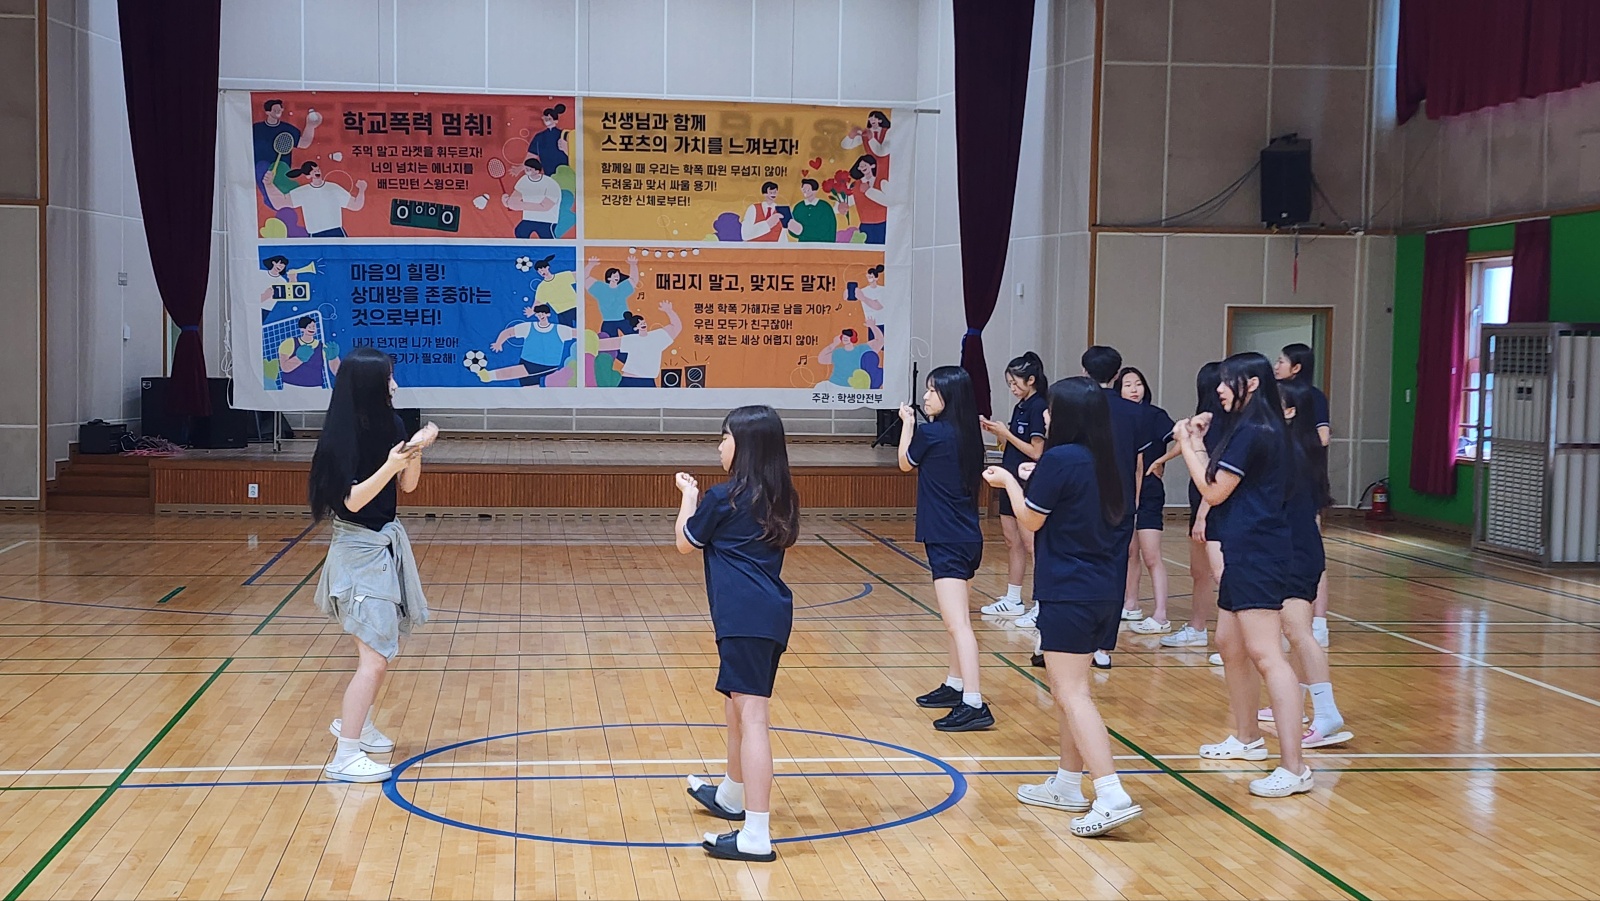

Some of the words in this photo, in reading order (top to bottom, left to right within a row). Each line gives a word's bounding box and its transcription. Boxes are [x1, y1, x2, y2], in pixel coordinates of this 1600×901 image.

[343, 111, 432, 135] 학교폭력
[442, 113, 492, 136] 멈춰!
[601, 112, 668, 130] 선생님과
[674, 114, 706, 132] 함께
[601, 135, 667, 153] 스포츠의
[674, 136, 723, 154] 가치를
[729, 137, 799, 156] 느껴보자!
[352, 146, 372, 157] 주먹
[377, 146, 398, 157] 말고
[402, 146, 433, 157] 라켓을
[437, 146, 483, 158] 휘두르자!
[372, 162, 392, 173] 너의
[396, 162, 428, 174] 넘치는
[432, 163, 473, 174] 에너지를
[601, 163, 632, 174] 함께일
[636, 163, 646, 174] 때
[649, 163, 680, 175] 우리는
[683, 164, 703, 176] 학폭
[707, 164, 727, 176] 따윈
[731, 165, 760, 177] 무섭지
[765, 166, 788, 177] 않아!
[378, 179, 419, 190] 배드민턴
[424, 179, 469, 190] 스윙으로!
[601, 179, 643, 190] 두려움과
[646, 179, 666, 190] 맞서
[670, 180, 690, 191] 싸울
[694, 180, 717, 191] 용기!
[601, 195, 632, 206] 건강한
[636, 195, 690, 206] 신체로부터!
[351, 263, 400, 281] 마음의
[407, 263, 445, 281] 힐링!
[656, 273, 701, 291] 때리지
[708, 274, 745, 292] 말고,
[750, 274, 795, 291] 맞지도
[801, 275, 836, 292] 말자!
[351, 286, 419, 304] 상대방을
[425, 286, 491, 304] 존중하는
[694, 303, 714, 314] 평생
[718, 303, 738, 314] 학폭
[741, 304, 780, 315] 가해자로
[783, 304, 802, 315] 남을
[806, 304, 831, 315] 거야?
[352, 309, 441, 326] 것으로부터!
[694, 319, 714, 330] 우린
[718, 319, 748, 330] 모두가
[751, 319, 792, 330] 친구잖아!
[352, 338, 374, 348] 내가
[377, 337, 407, 348] 던지면
[412, 337, 432, 348] 니가
[435, 337, 459, 348] 받아!
[694, 334, 714, 346] 학폭
[718, 334, 737, 346] 없는
[741, 335, 759, 346] 세상
[763, 335, 792, 346] 어렵지
[796, 335, 818, 346] 않아!
[422, 353, 456, 364] 필요해!
[812, 393, 830, 403] 주관
[837, 393, 883, 404] 학생안전부
[1076, 823, 1102, 833] crocs
